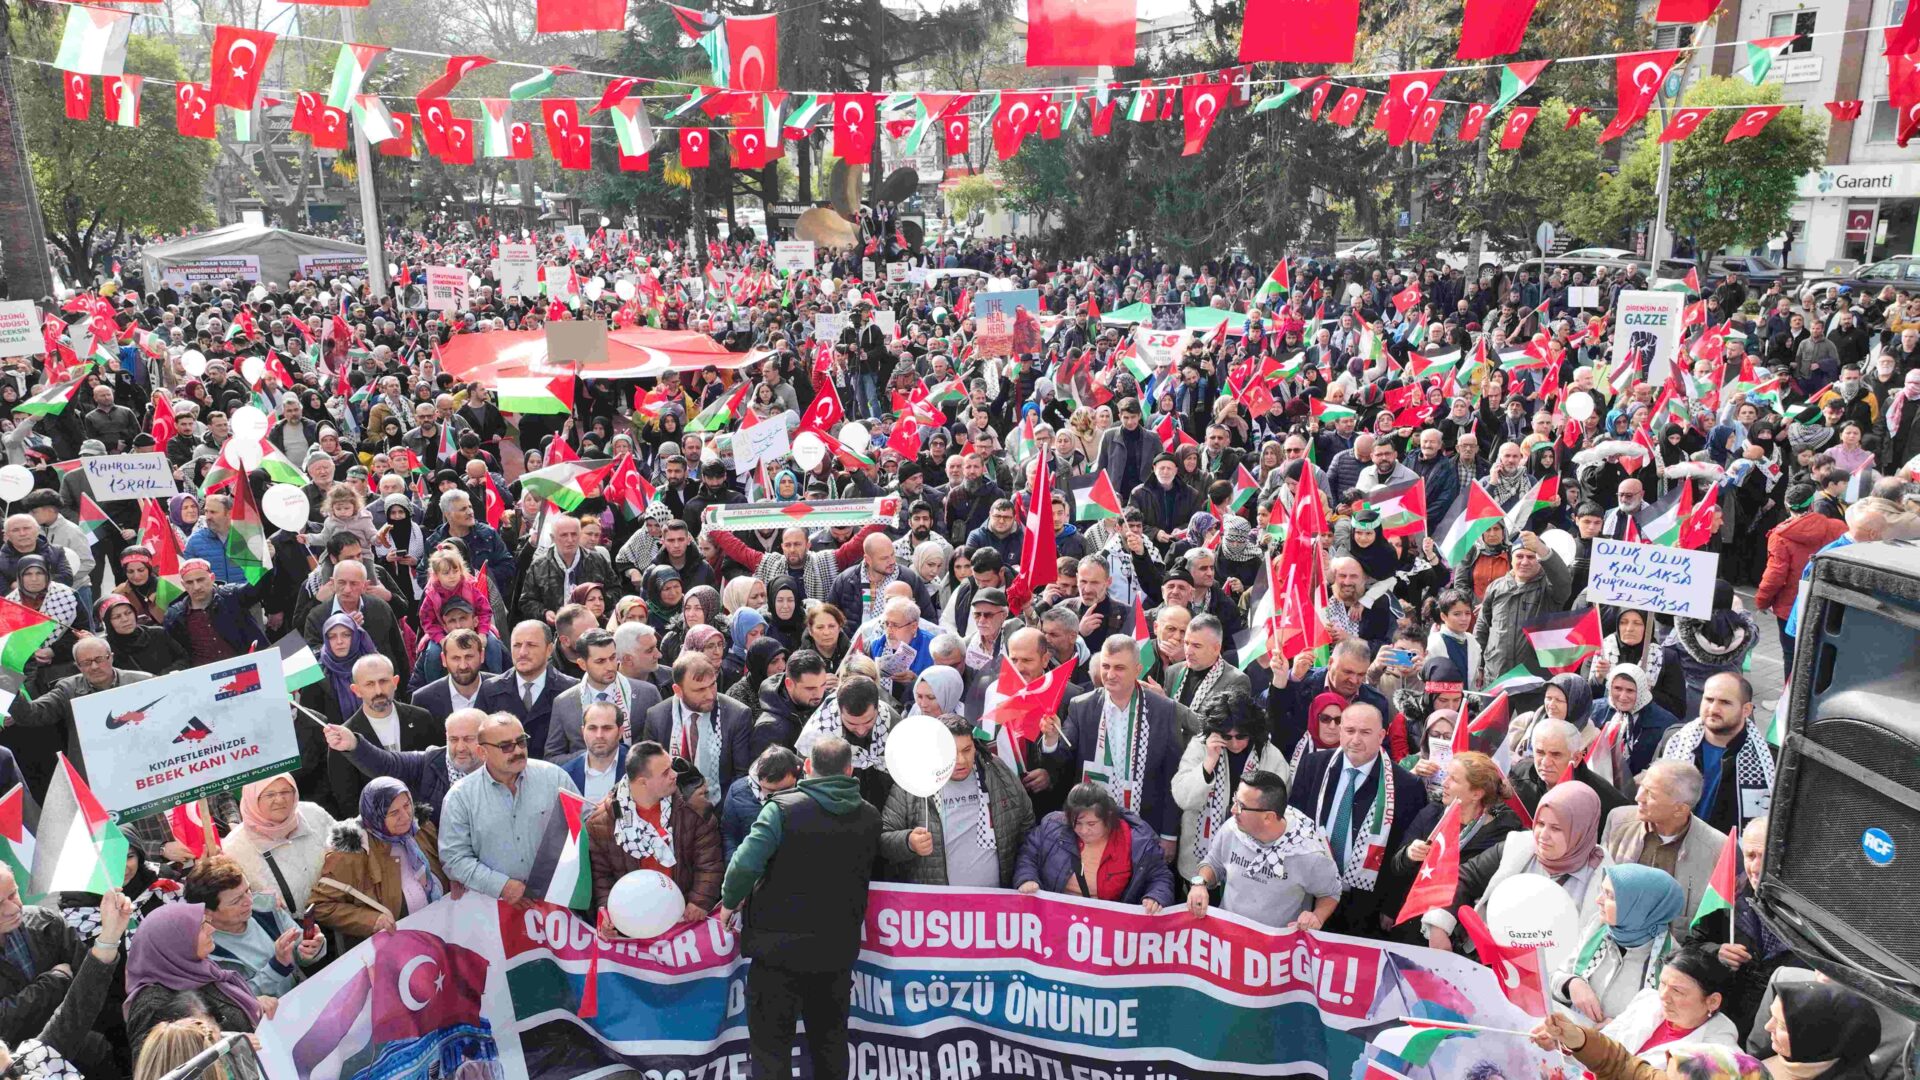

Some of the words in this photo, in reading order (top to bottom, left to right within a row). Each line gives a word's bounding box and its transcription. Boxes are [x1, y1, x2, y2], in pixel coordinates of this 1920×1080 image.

[1836, 174, 1893, 189] Garanti
[434, 290, 452, 298] YETER
[985, 298, 1003, 312] THE
[986, 311, 1004, 323] REAL
[987, 323, 1005, 335] HERO
[1624, 313, 1668, 326] GAZZE
[1597, 542, 1642, 566] OLUK
[1649, 551, 1692, 574] OLUK
[1609, 561, 1646, 577] KAN
[1646, 568, 1692, 585] AKSA
[148, 737, 247, 772] KIYAFETLERİNİZDE
[135, 767, 185, 791] BEBEK
[188, 756, 227, 775] KANI
[230, 744, 260, 761] VAR
[123, 801, 160, 817] GÖLCÜK
[162, 790, 191, 806] KUDÜS
[193, 772, 251, 795] GÖNÜLLÜLERİ
[252, 758, 297, 776] PLATFORMU
[1864, 831, 1894, 856] RCF
[1508, 929, 1553, 939] Gazze'ye
[524, 908, 701, 968] ÇOCAR
[878, 908, 1053, 960] SUSULUR,
[1243, 939, 1359, 1005] DEĞİL!
[904, 974, 995, 1016] GÖZÜ
[1005, 974, 1139, 1039] ÖNÜNDE
